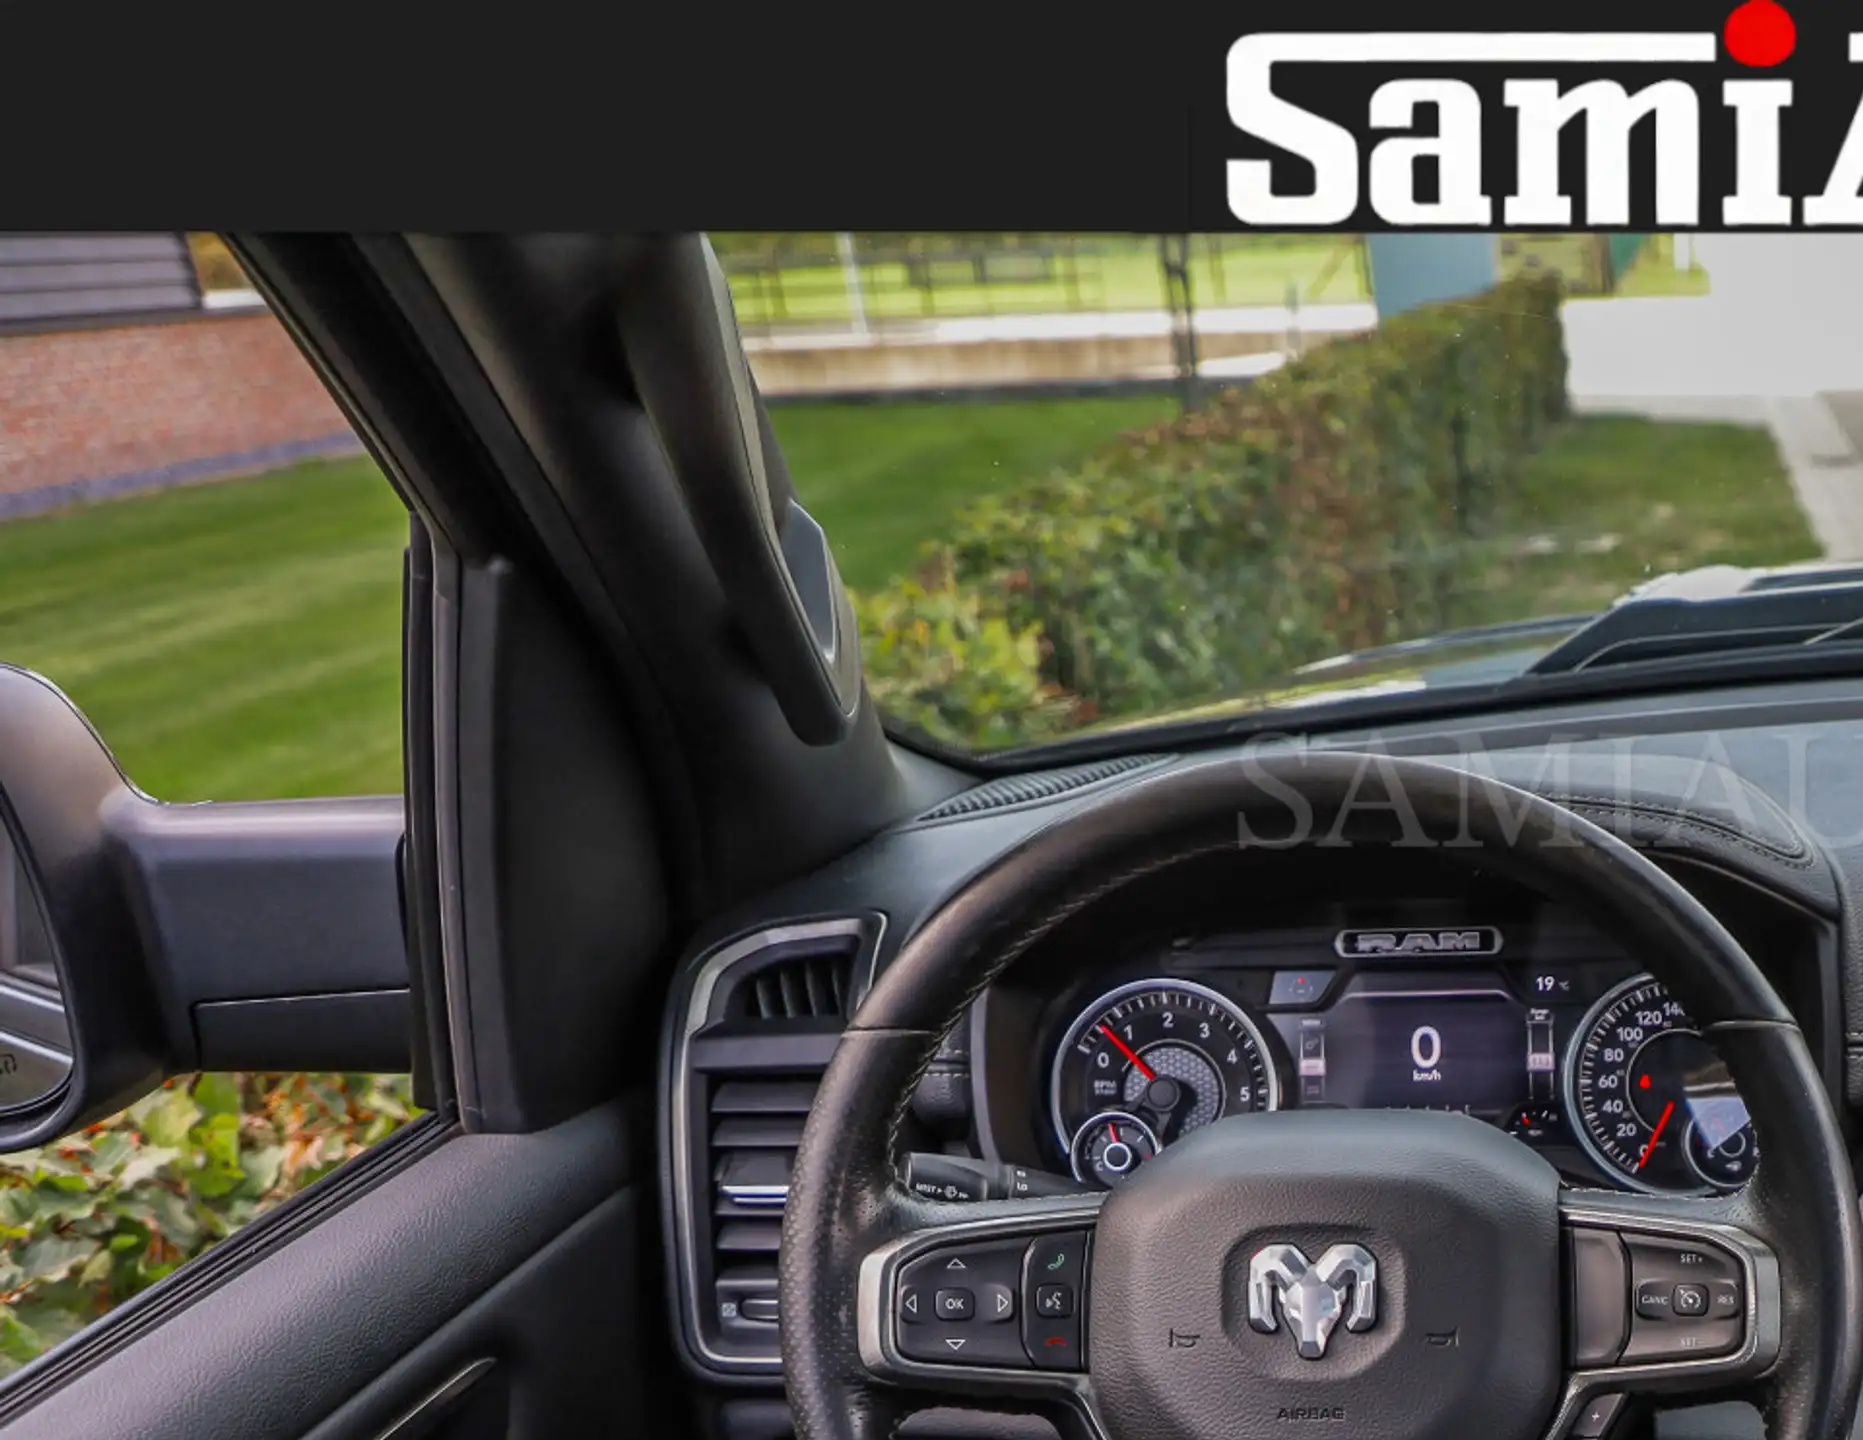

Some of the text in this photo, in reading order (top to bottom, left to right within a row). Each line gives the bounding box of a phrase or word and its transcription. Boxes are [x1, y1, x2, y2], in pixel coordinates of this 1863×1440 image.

[1357, 932, 1480, 951] RAM
[1535, 976, 1555, 992] 19
[1663, 1002, 1685, 1017] 14
[1162, 1012, 1174, 1028] 2
[1636, 1011, 1662, 1026] 120
[1124, 1025, 1133, 1040] 1
[1199, 1022, 1211, 1038] 3
[1616, 1027, 1644, 1042] 100
[1411, 1025, 1442, 1069] 0
[1097, 1054, 1110, 1068] 0
[1227, 1050, 1238, 1065] 4
[1604, 1048, 1625, 1063] 80
[1412, 1069, 1442, 1082] km/h
[1598, 1074, 1618, 1089] 60
[1240, 1087, 1250, 1101] 5
[1602, 1099, 1624, 1114] 40
[1616, 1123, 1637, 1137] 20
[945, 1298, 965, 1310] OK
[1642, 1296, 1669, 1306] CANC
[1277, 1407, 1346, 1421] AIRBAG
